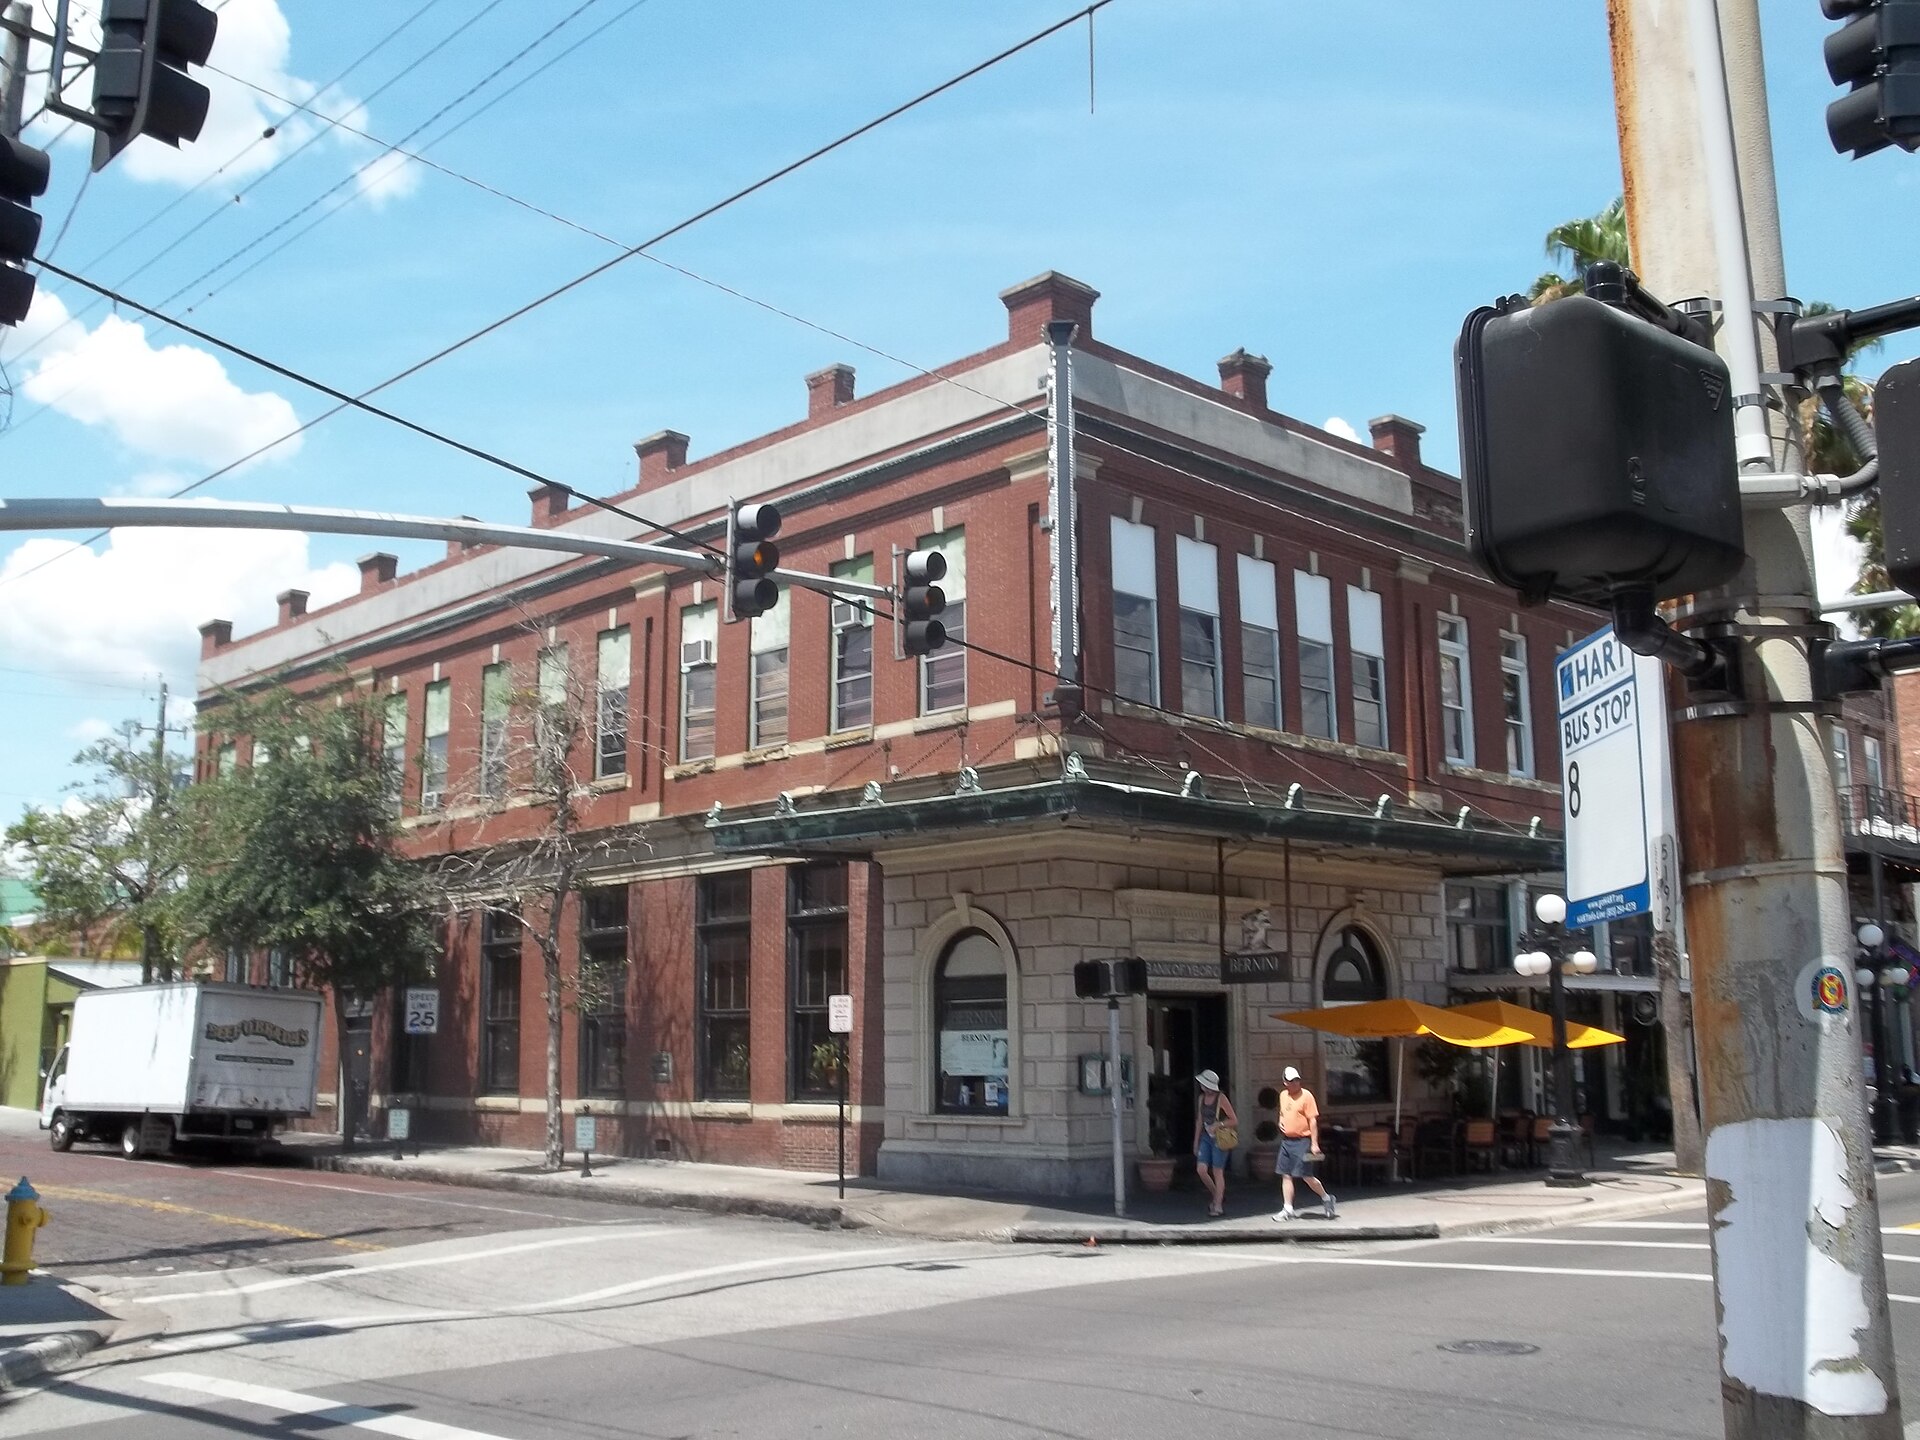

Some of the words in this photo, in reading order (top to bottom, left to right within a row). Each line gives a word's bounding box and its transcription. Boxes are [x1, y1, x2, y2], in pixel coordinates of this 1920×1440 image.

[1574, 637, 1625, 692] HART
[1564, 715, 1590, 749] BUS
[1594, 688, 1632, 735] STOP
[1567, 760, 1582, 819] 8
[1661, 843, 1672, 923] 5192
[1229, 957, 1279, 973] BERNINI
[408, 993, 437, 1001] SPEED
[411, 1002, 432, 1010] LIMIT
[409, 1011, 435, 1027] 25
[961, 1033, 992, 1042] BERNINI
